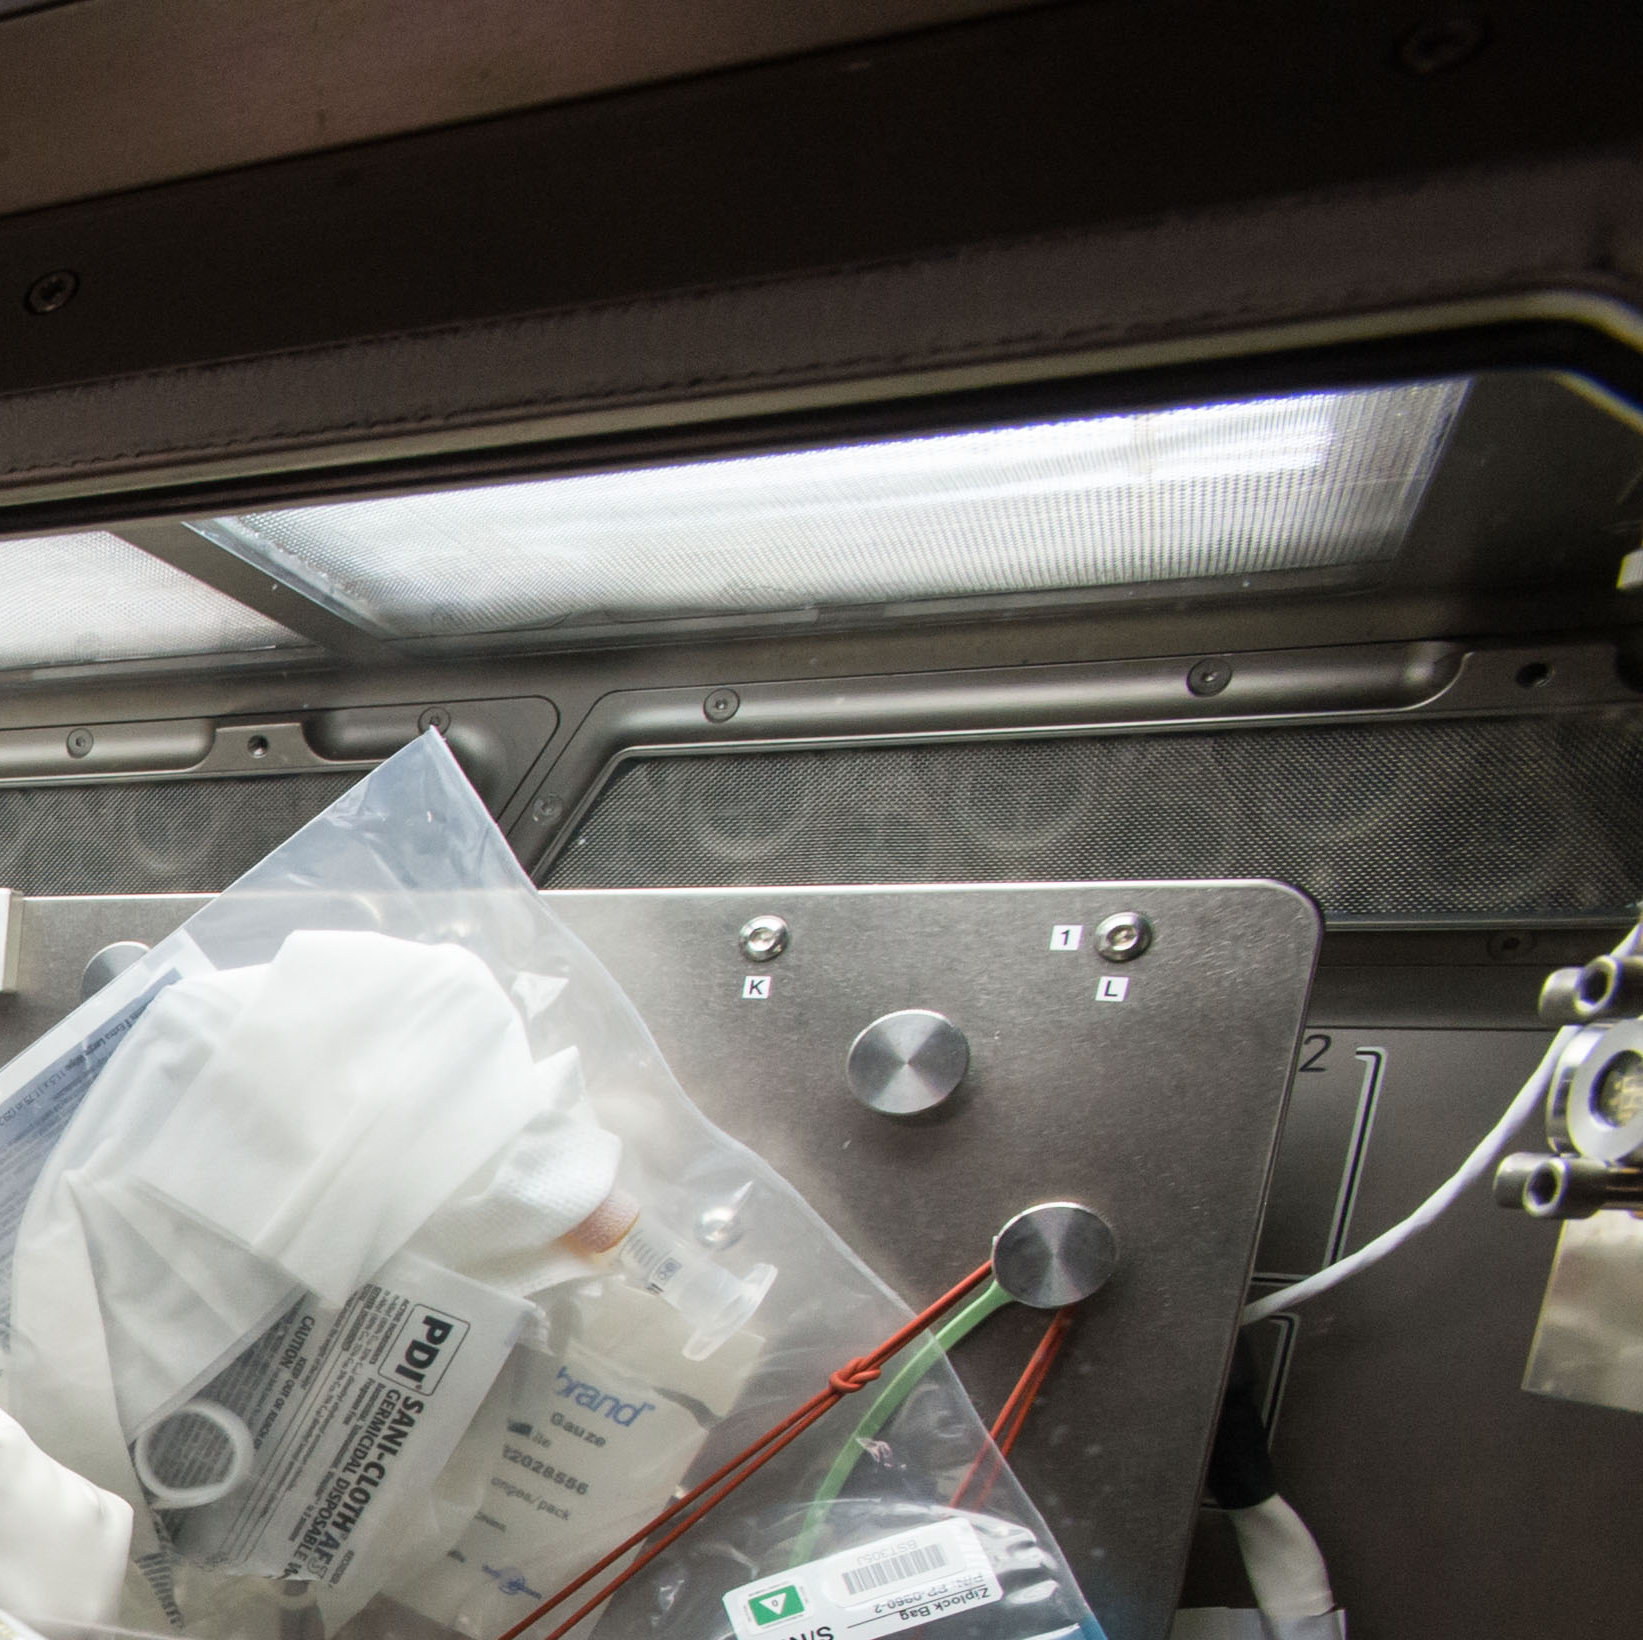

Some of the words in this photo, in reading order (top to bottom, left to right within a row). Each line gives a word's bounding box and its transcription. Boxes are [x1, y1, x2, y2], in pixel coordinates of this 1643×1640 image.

[1060, 929, 1071, 946] 1
[749, 979, 764, 995] K
[1104, 981, 1119, 997] L
[1297, 1034, 1332, 1072] 2
[278, 1313, 316, 1370] CAUTION
[394, 1312, 453, 1386] PDI
[288, 1355, 307, 1379] KEEP
[278, 1378, 295, 1397] OUT
[271, 1396, 285, 1411] OF
[256, 1409, 278, 1439] REACH
[342, 1386, 403, 1478] GERMICIDAL
[548, 1410, 609, 1449] Gauze
[330, 1394, 425, 1535] SANI-CLOTH
[293, 1476, 350, 1562] DISPOSABLE
[898, 1602, 930, 1623] Bag
[931, 1584, 990, 1613] Ziplock
